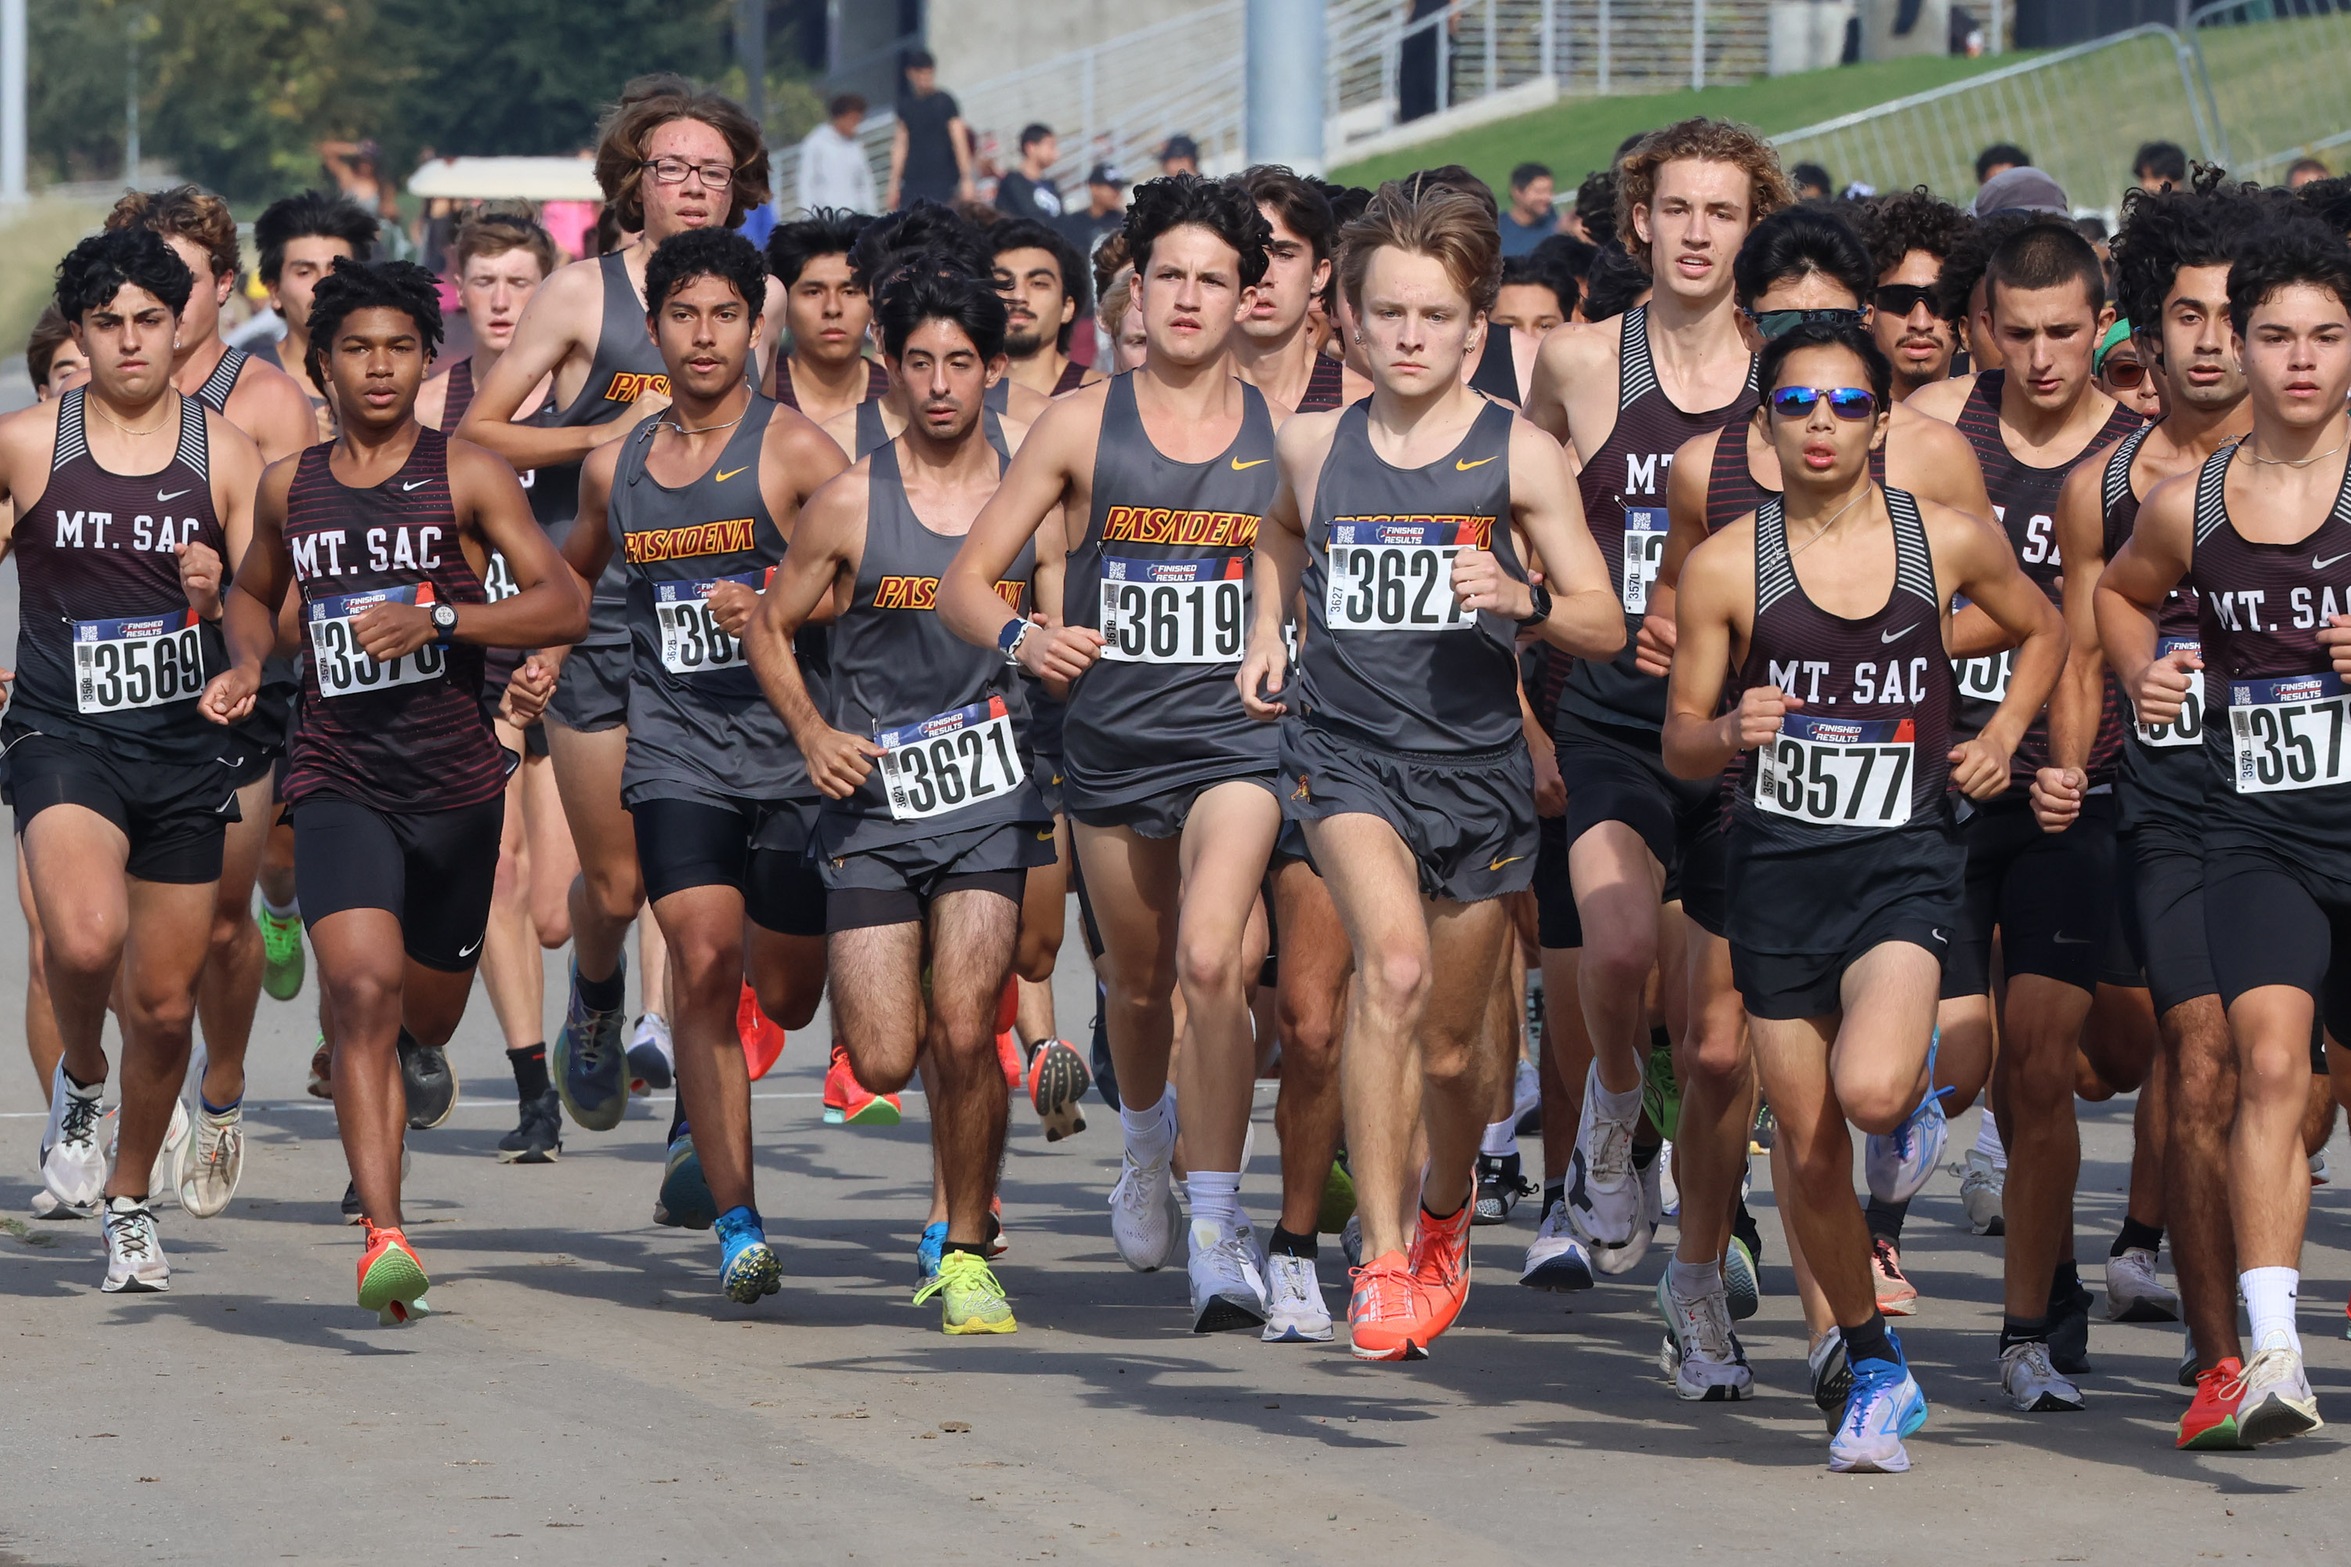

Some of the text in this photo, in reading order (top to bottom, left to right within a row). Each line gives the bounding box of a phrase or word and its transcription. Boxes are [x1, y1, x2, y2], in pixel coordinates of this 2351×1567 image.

[55, 510, 200, 553] MT. SAC
[624, 518, 755, 563] PASADENA
[1384, 536, 1423, 544] RESULTS
[1386, 526, 1425, 535] FINISHED
[291, 526, 442, 582] MT. SAC
[1156, 573, 1195, 582] RESULTS
[1157, 564, 1198, 573] FINISHED
[1628, 573, 1640, 600] 3570
[350, 594, 386, 605] FINISHED
[1329, 586, 1344, 613] 3627
[2208, 590, 2278, 632] MT.
[127, 620, 164, 629] FINISHED
[1119, 583, 1240, 657] 3619
[126, 628, 162, 638] RESULTS
[1105, 619, 1117, 646] 3619
[667, 639, 677, 662] 3625
[2173, 642, 2201, 650] FINISH
[94, 629, 202, 707] 3569
[1769, 659, 1836, 704] MT.
[1852, 656, 1928, 704] SAC
[82, 677, 93, 701] 3569
[2280, 680, 2322, 692] FINISHED
[2280, 690, 2322, 702] RESULTS
[928, 713, 963, 729] FINISHED
[928, 721, 963, 738] RESULTS
[1818, 723, 1862, 734] FINISHED
[1815, 733, 1859, 743] RESULTS
[2250, 700, 2351, 785] 357
[900, 721, 1017, 813] 3621
[1763, 768, 1774, 795] 3577
[1777, 739, 1911, 820] 3577
[892, 785, 907, 809] 3621
